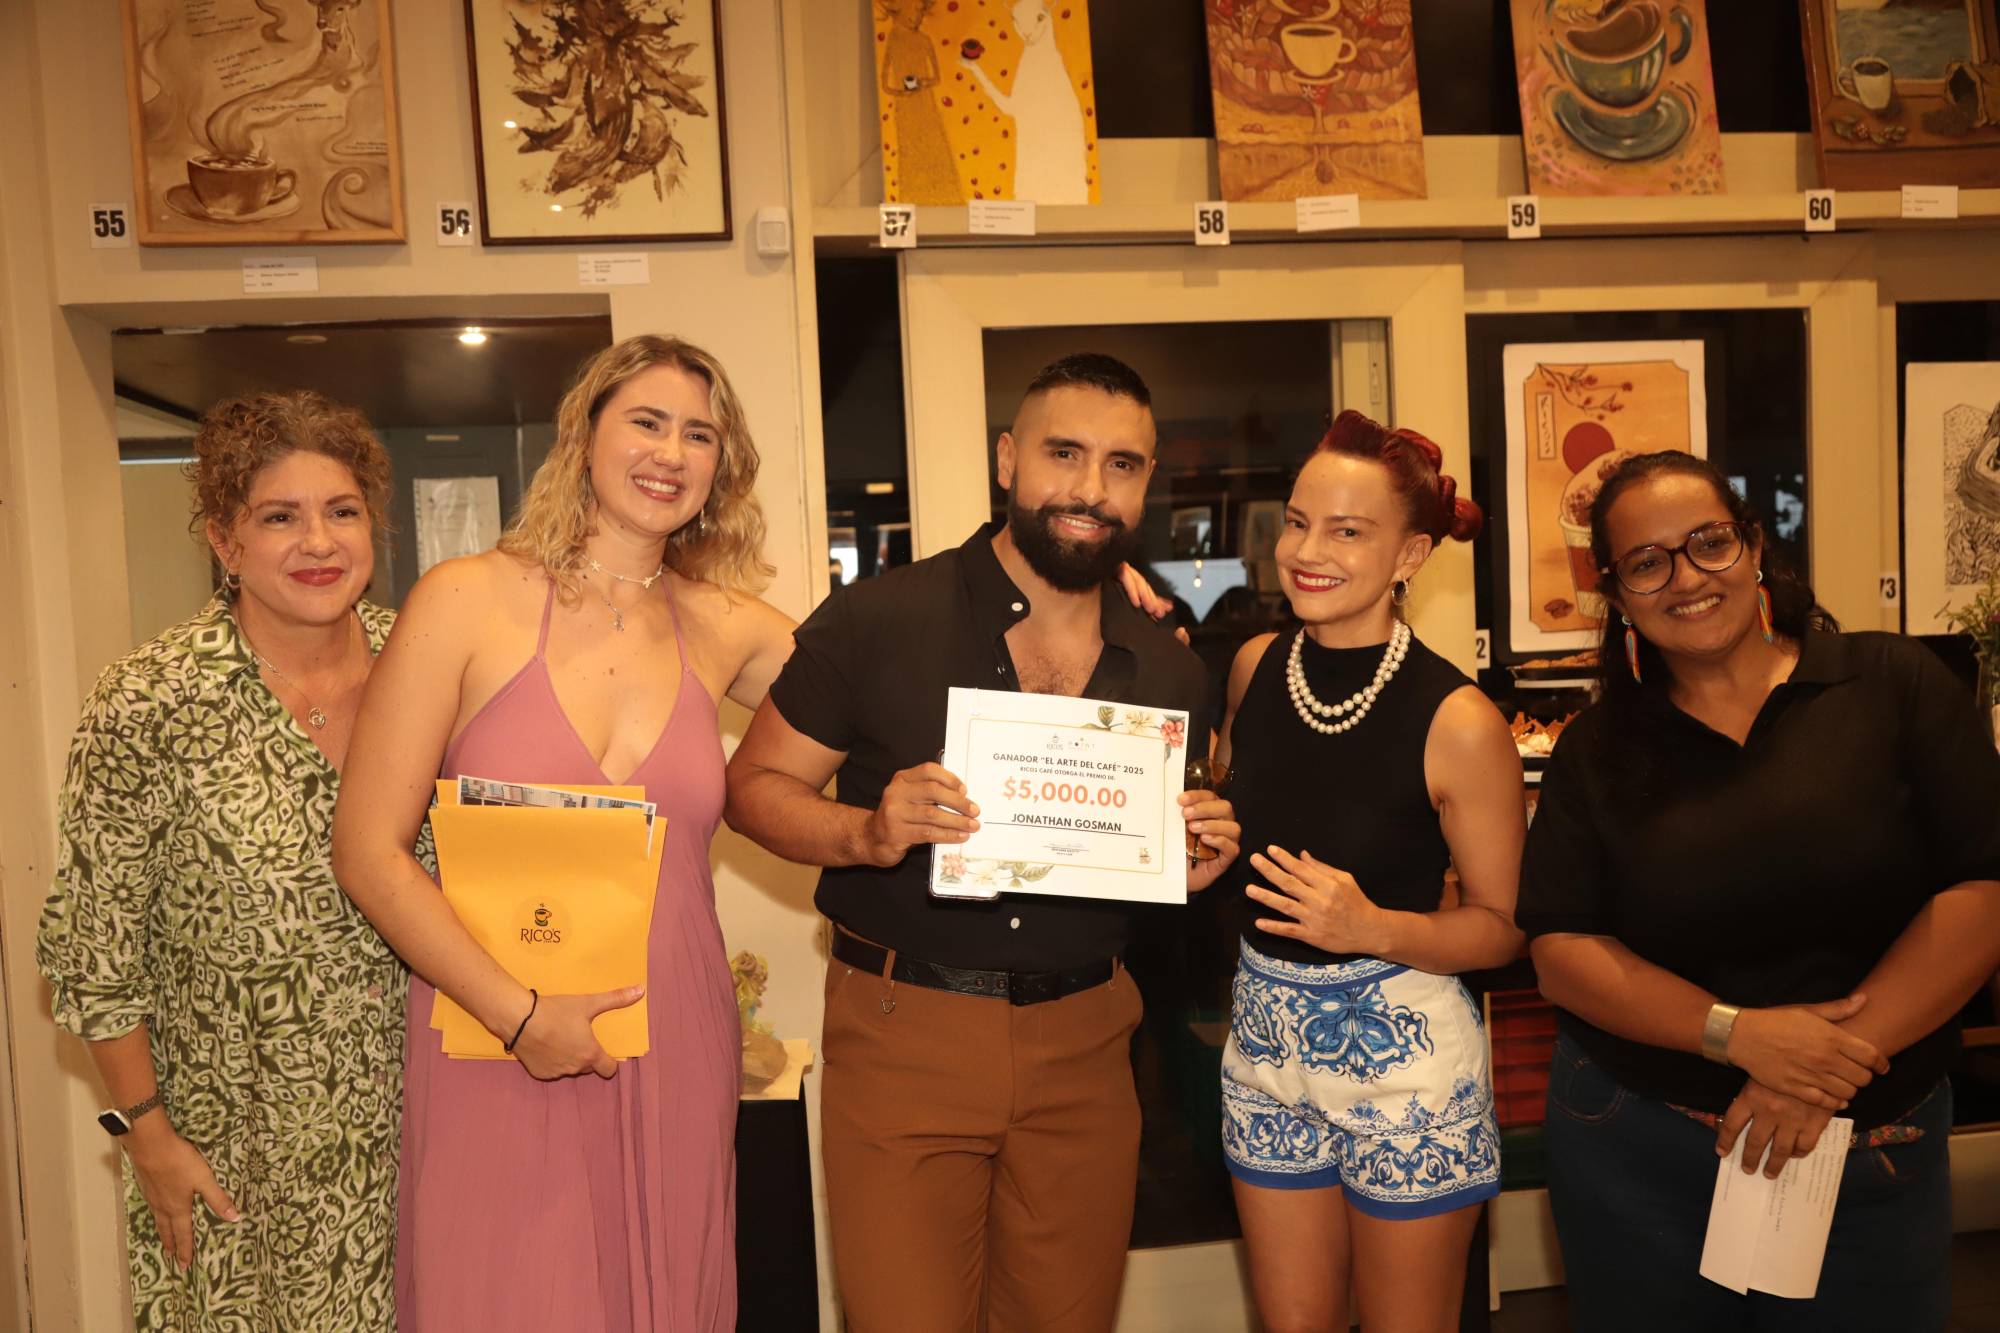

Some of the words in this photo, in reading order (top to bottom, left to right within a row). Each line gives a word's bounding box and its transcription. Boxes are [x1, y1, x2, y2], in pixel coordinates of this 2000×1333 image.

[1199, 209, 1225, 234] 58
[1511, 203, 1536, 228] 59
[1809, 197, 1832, 221] 60
[93, 209, 126, 238] 55
[441, 208, 471, 236] 56
[884, 211, 912, 237] 57
[993, 753, 1039, 763] GANADOR
[1056, 758, 1078, 768] ARTE
[1080, 760, 1096, 769] DEL
[1123, 765, 1145, 775] 2025
[1054, 769, 1078, 777] OTORGA
[1003, 776, 1127, 809] $5,000.00
[1012, 813, 1072, 827] JONATHAN
[1074, 819, 1122, 832] GOSMAN
